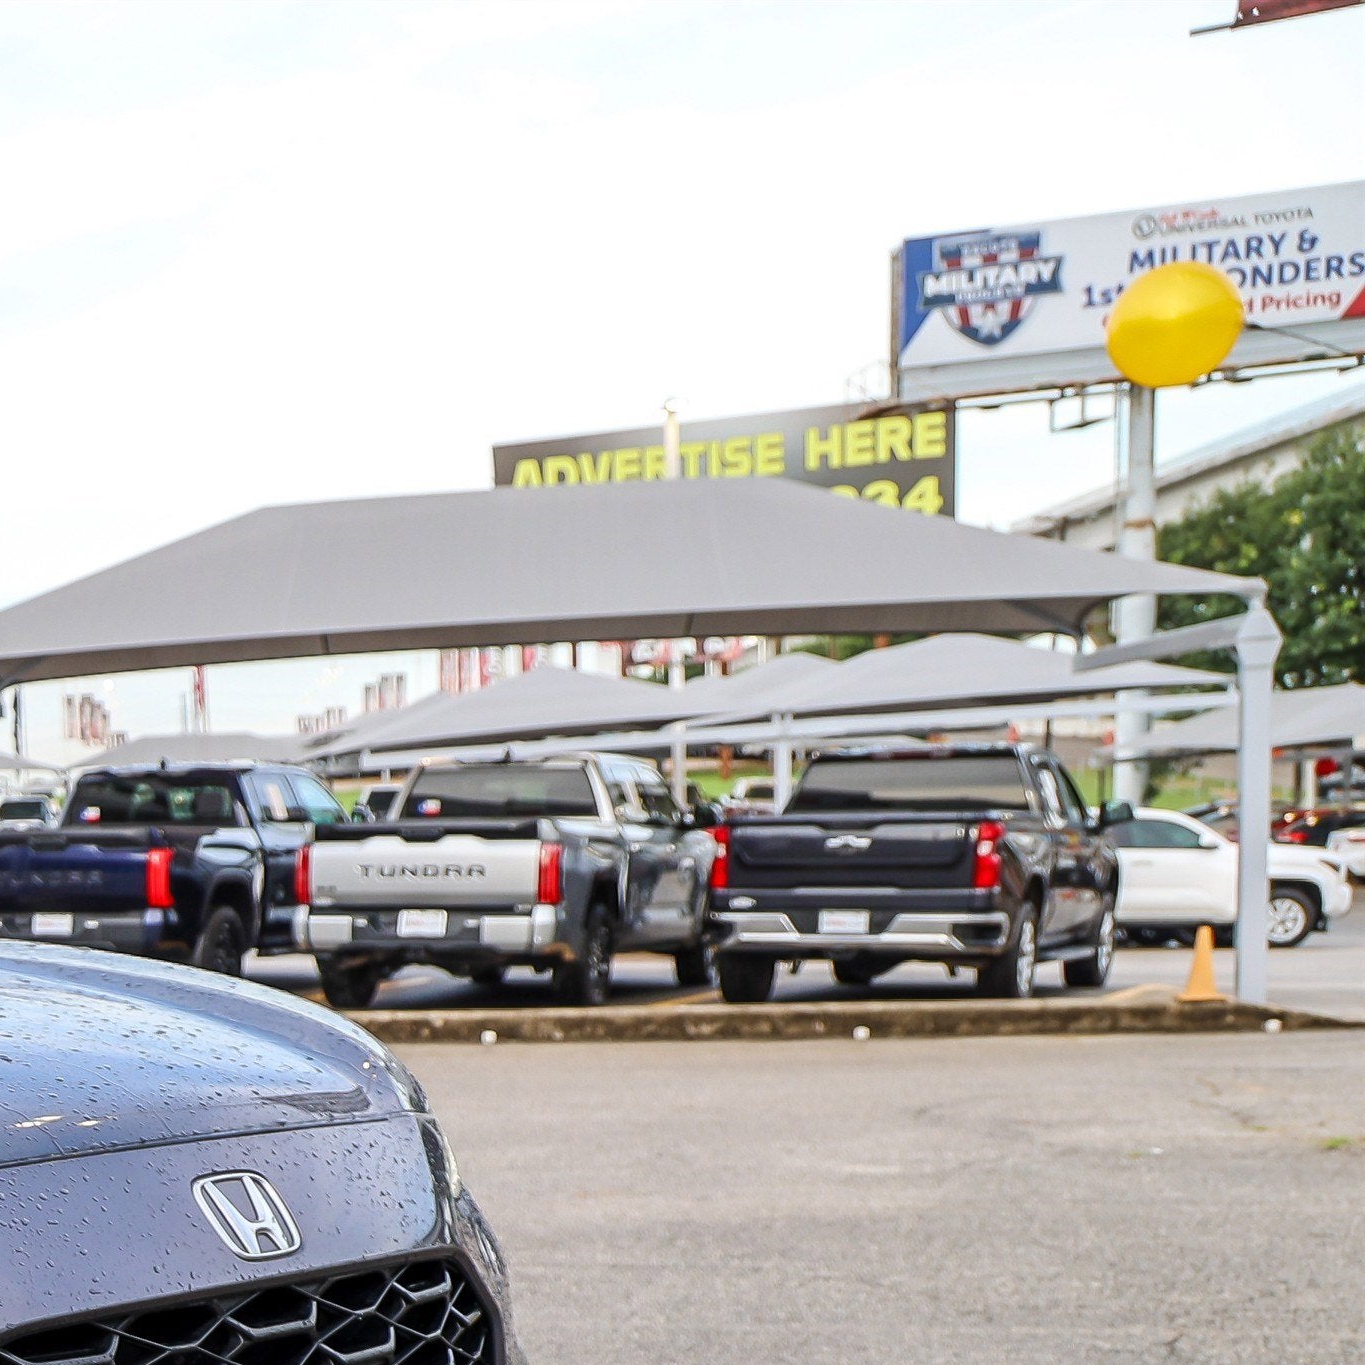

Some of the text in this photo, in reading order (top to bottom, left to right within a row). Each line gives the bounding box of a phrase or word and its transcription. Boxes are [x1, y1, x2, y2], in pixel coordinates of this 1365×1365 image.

[1254, 207, 1314, 226] TOYOTA
[1297, 228, 1319, 253] &
[922, 259, 1058, 298] MILITARY
[1226, 252, 1365, 288] ONDERS
[1261, 289, 1342, 313] Pricing
[512, 410, 947, 488] ADVERTISE HERE
[358, 863, 486, 878] TUNDRA
